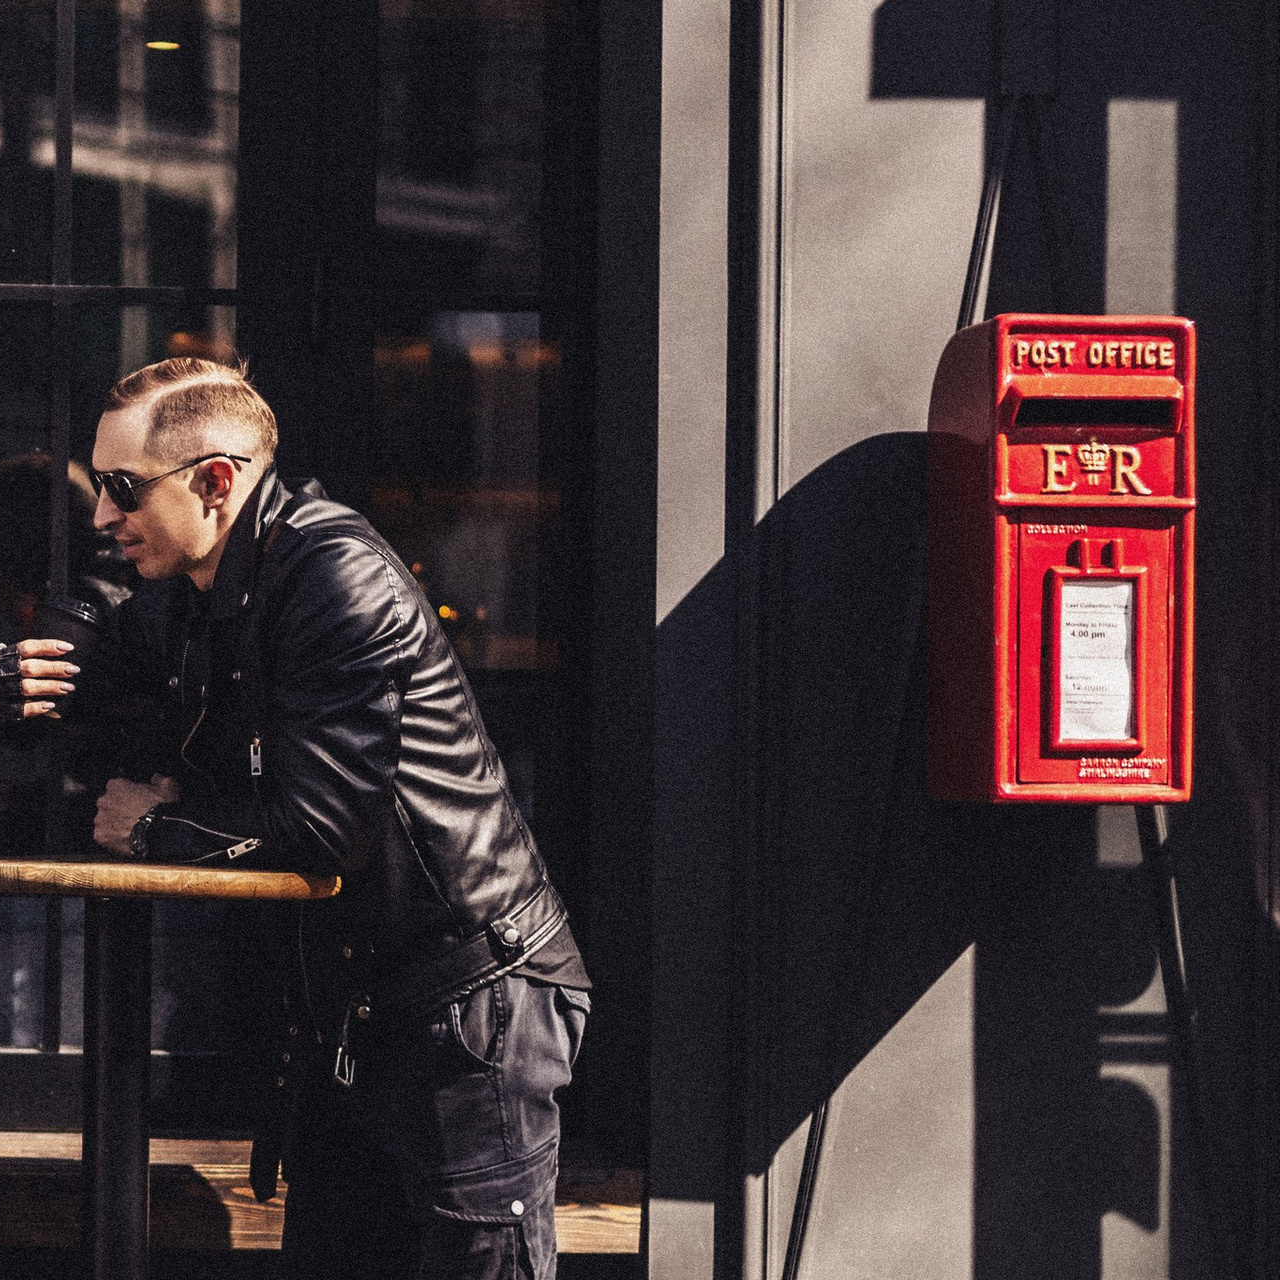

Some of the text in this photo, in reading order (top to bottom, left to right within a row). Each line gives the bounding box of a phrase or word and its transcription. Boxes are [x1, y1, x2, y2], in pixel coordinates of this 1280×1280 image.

[1016, 340, 1175, 367] POST OFFICE
[1027, 523, 1088, 535] COLLECTION
[1070, 630, 1106, 639] 4.00 pm
